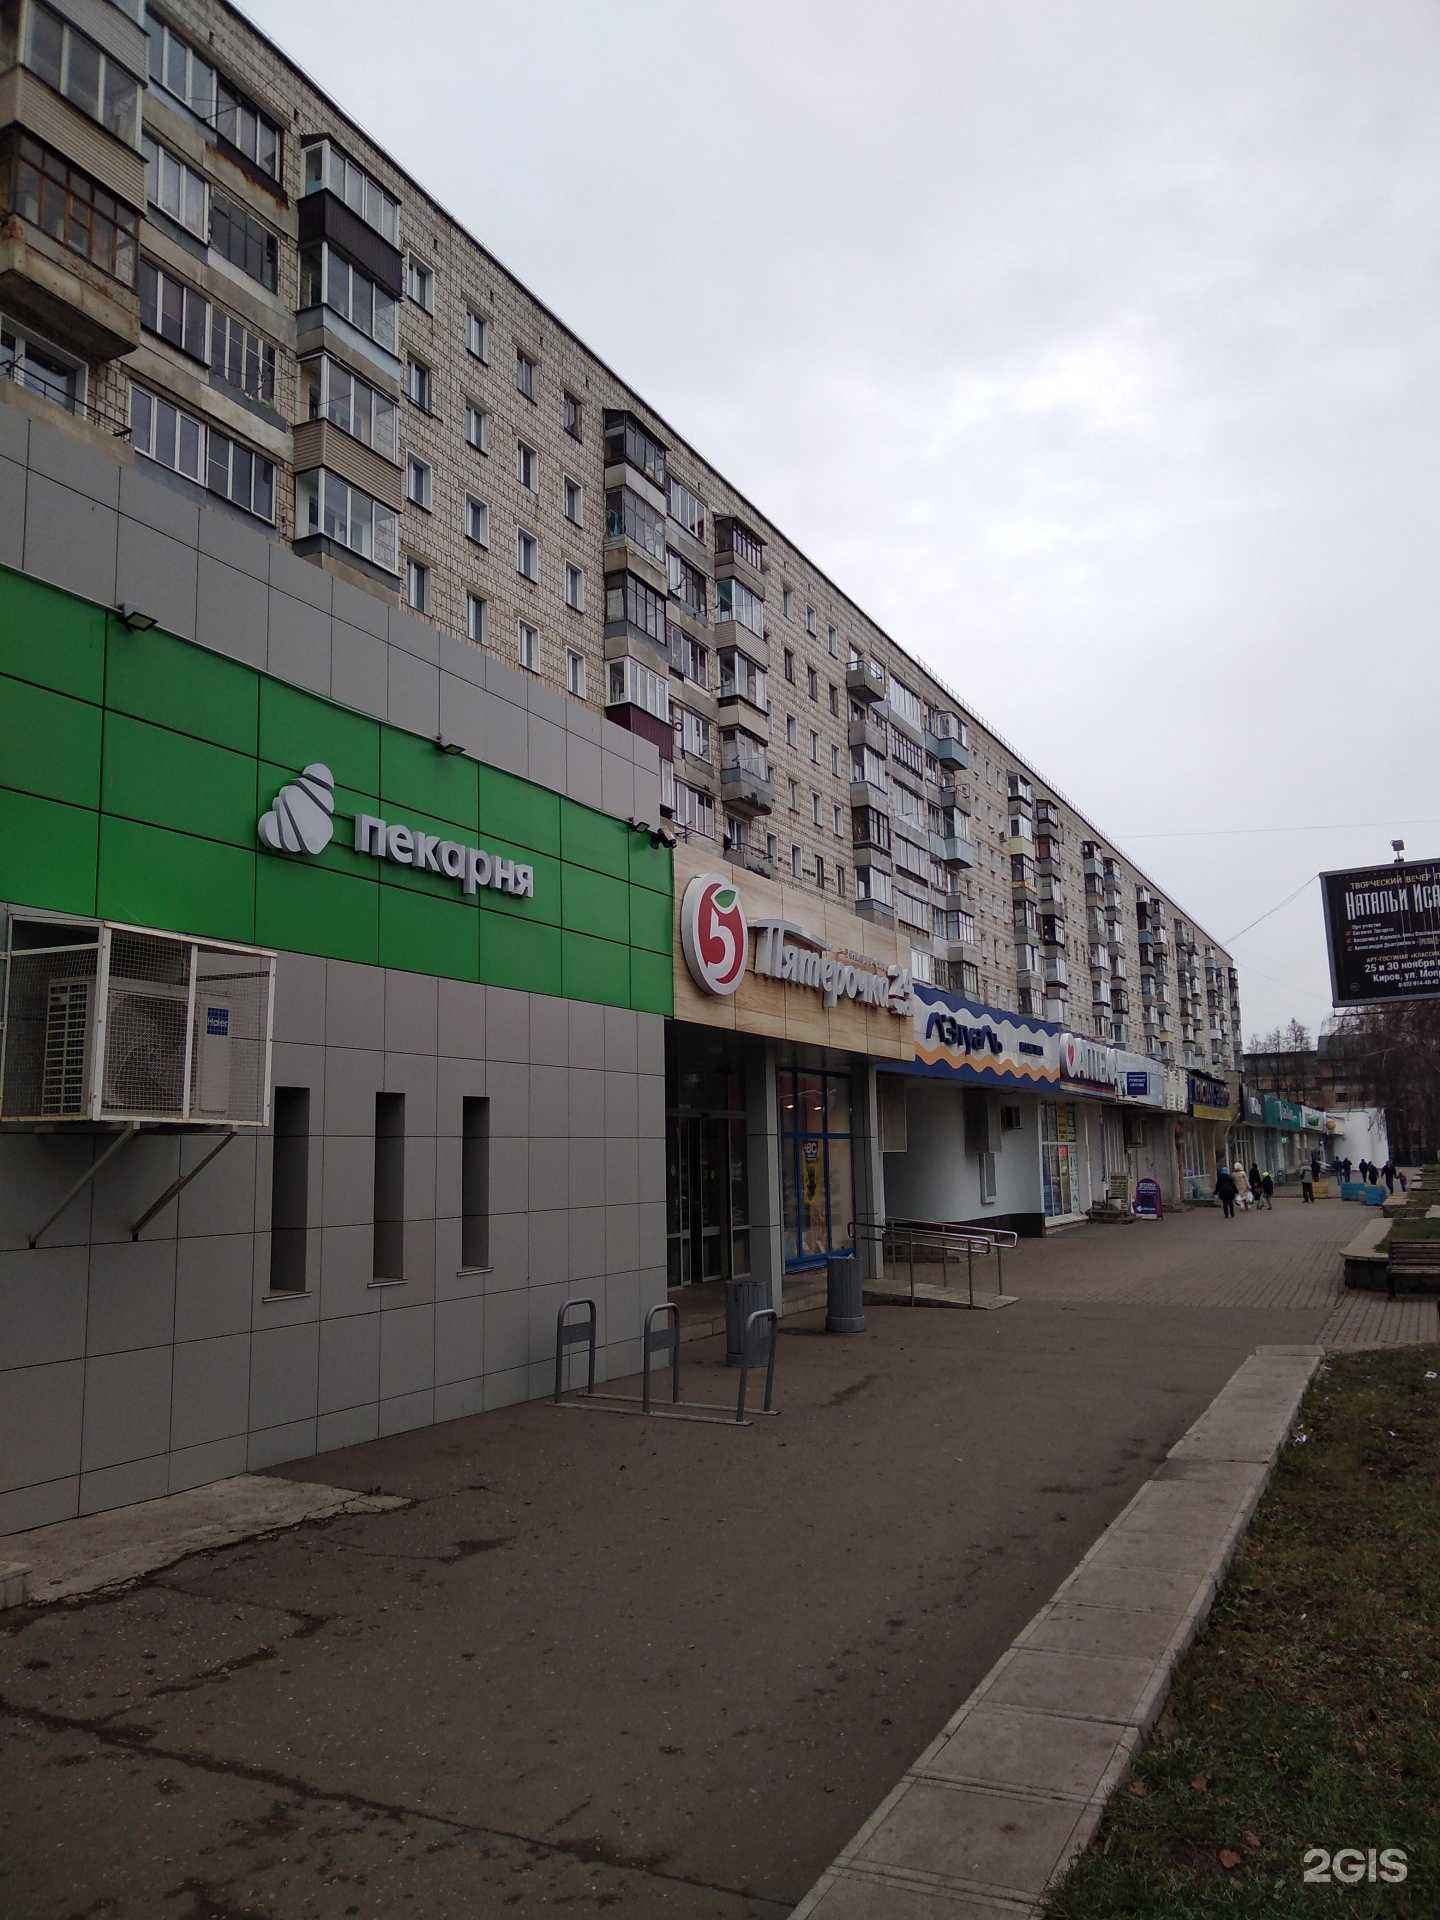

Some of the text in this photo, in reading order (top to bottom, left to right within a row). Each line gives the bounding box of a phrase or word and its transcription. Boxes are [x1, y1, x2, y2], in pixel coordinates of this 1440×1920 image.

[1350, 874, 1403, 890] ТВОРЧЕСКИЙ
[1405, 873, 1431, 884] ВЕЧЕР
[1364, 963, 1377, 973] 25
[1386, 961, 1399, 971] 30
[1401, 958, 1435, 970] ноября
